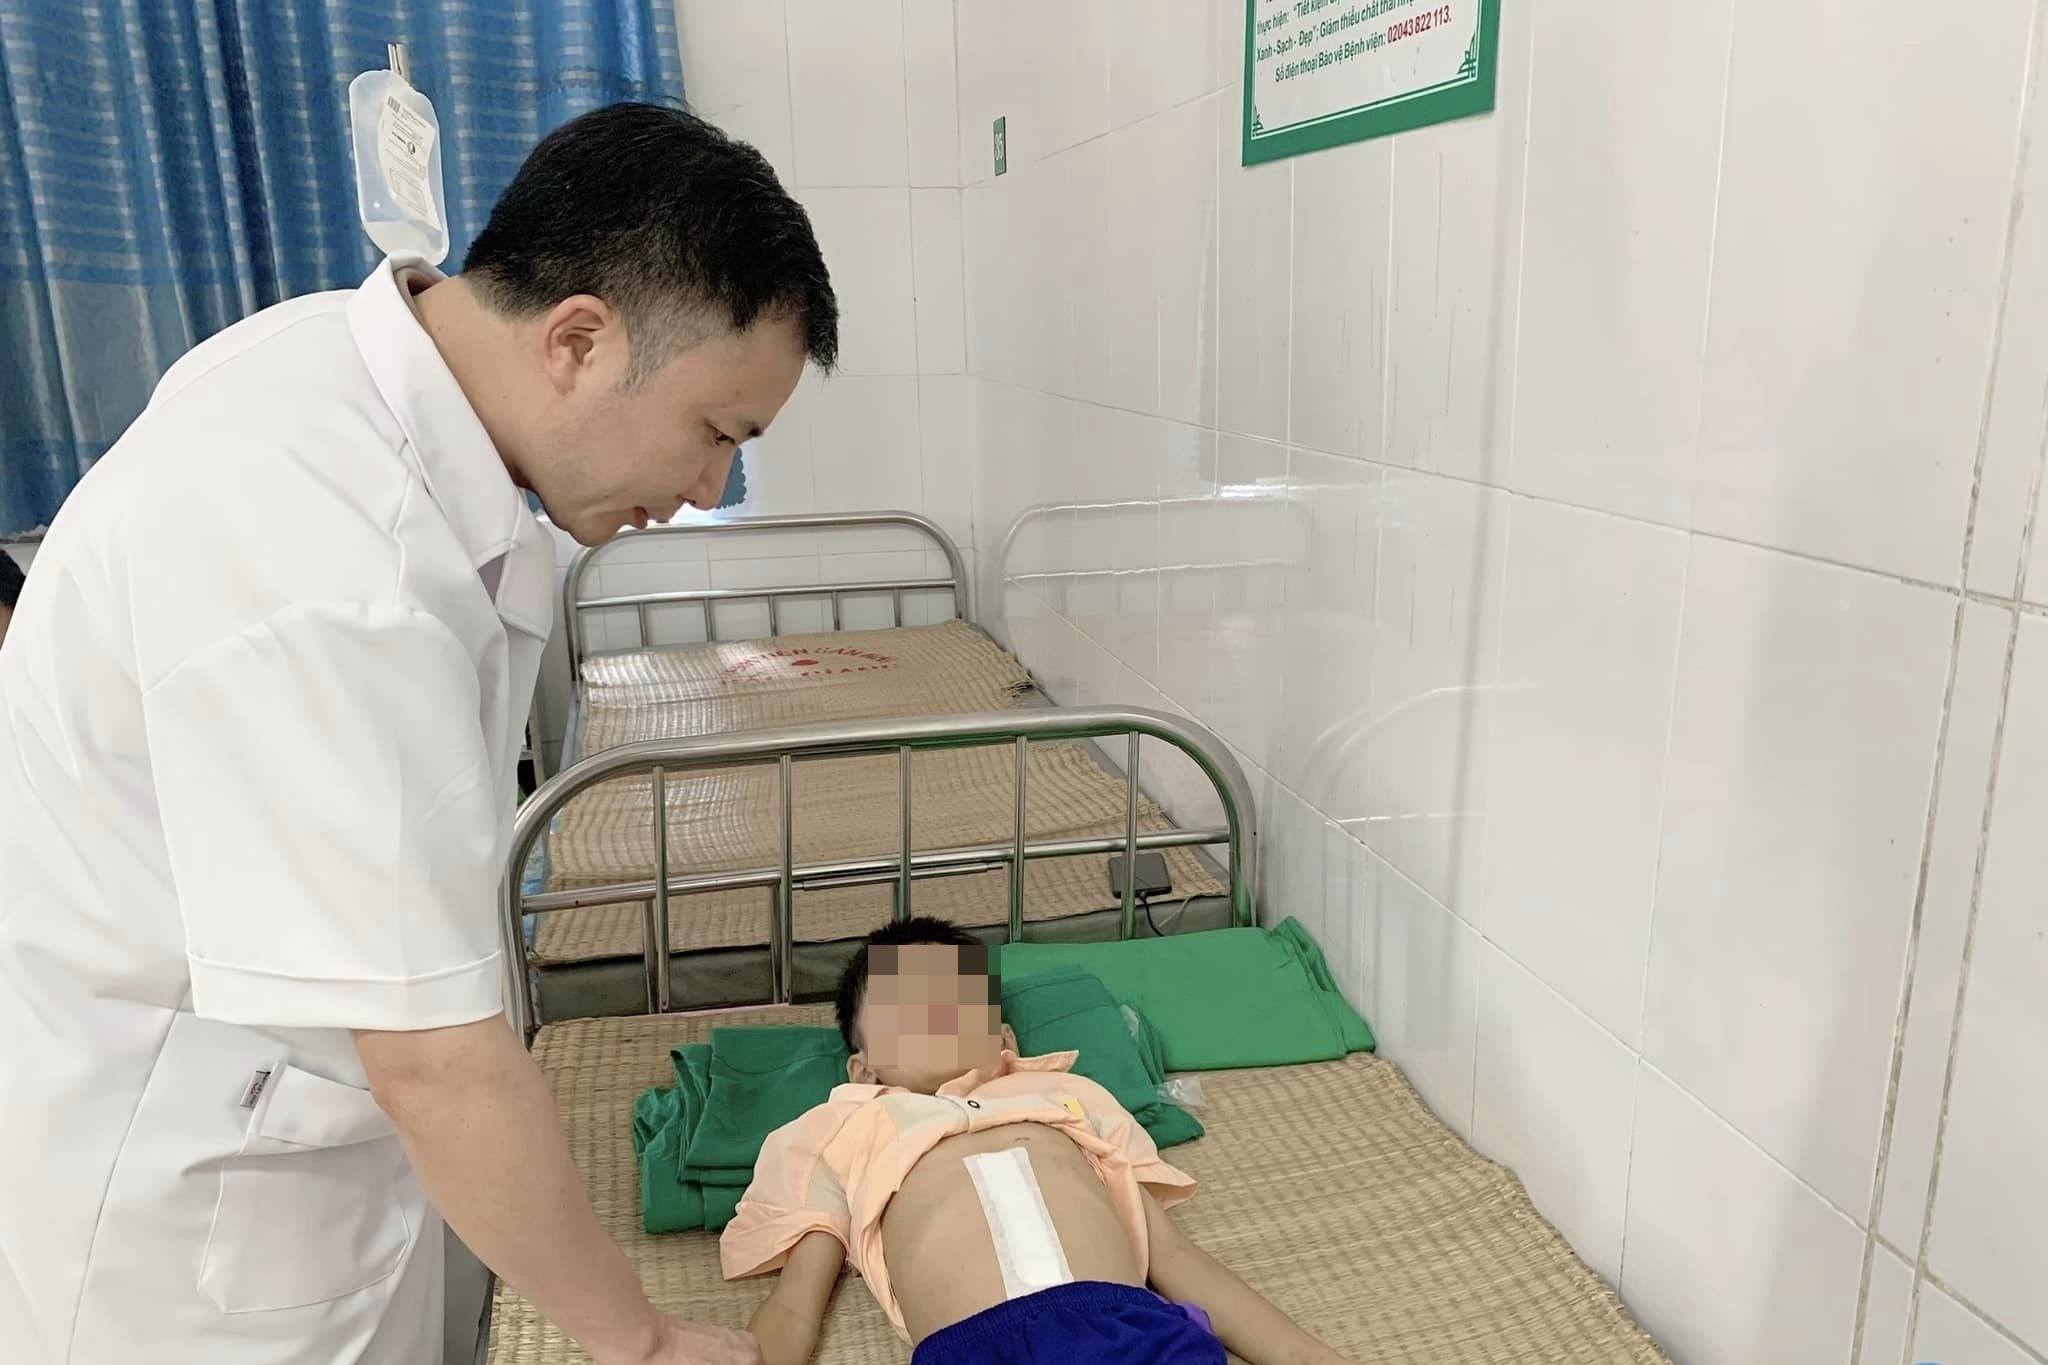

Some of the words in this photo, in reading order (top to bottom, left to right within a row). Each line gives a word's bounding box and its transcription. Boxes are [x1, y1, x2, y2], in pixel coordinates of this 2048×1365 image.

[1257, 44, 1273, 63] Xanh
[1320, 18, 1340, 37] Giảm
[1285, 61, 1300, 80] điện
[1300, 53, 1317, 75] thoại
[1318, 49, 1333, 68] Bảo
[1334, 44, 1343, 64] vệ
[1344, 40, 1365, 61] Bệnh
[1387, 18, 1413, 43] 02043
[1414, 11, 1431, 35] 822
[1433, 5, 1452, 28] 113.
